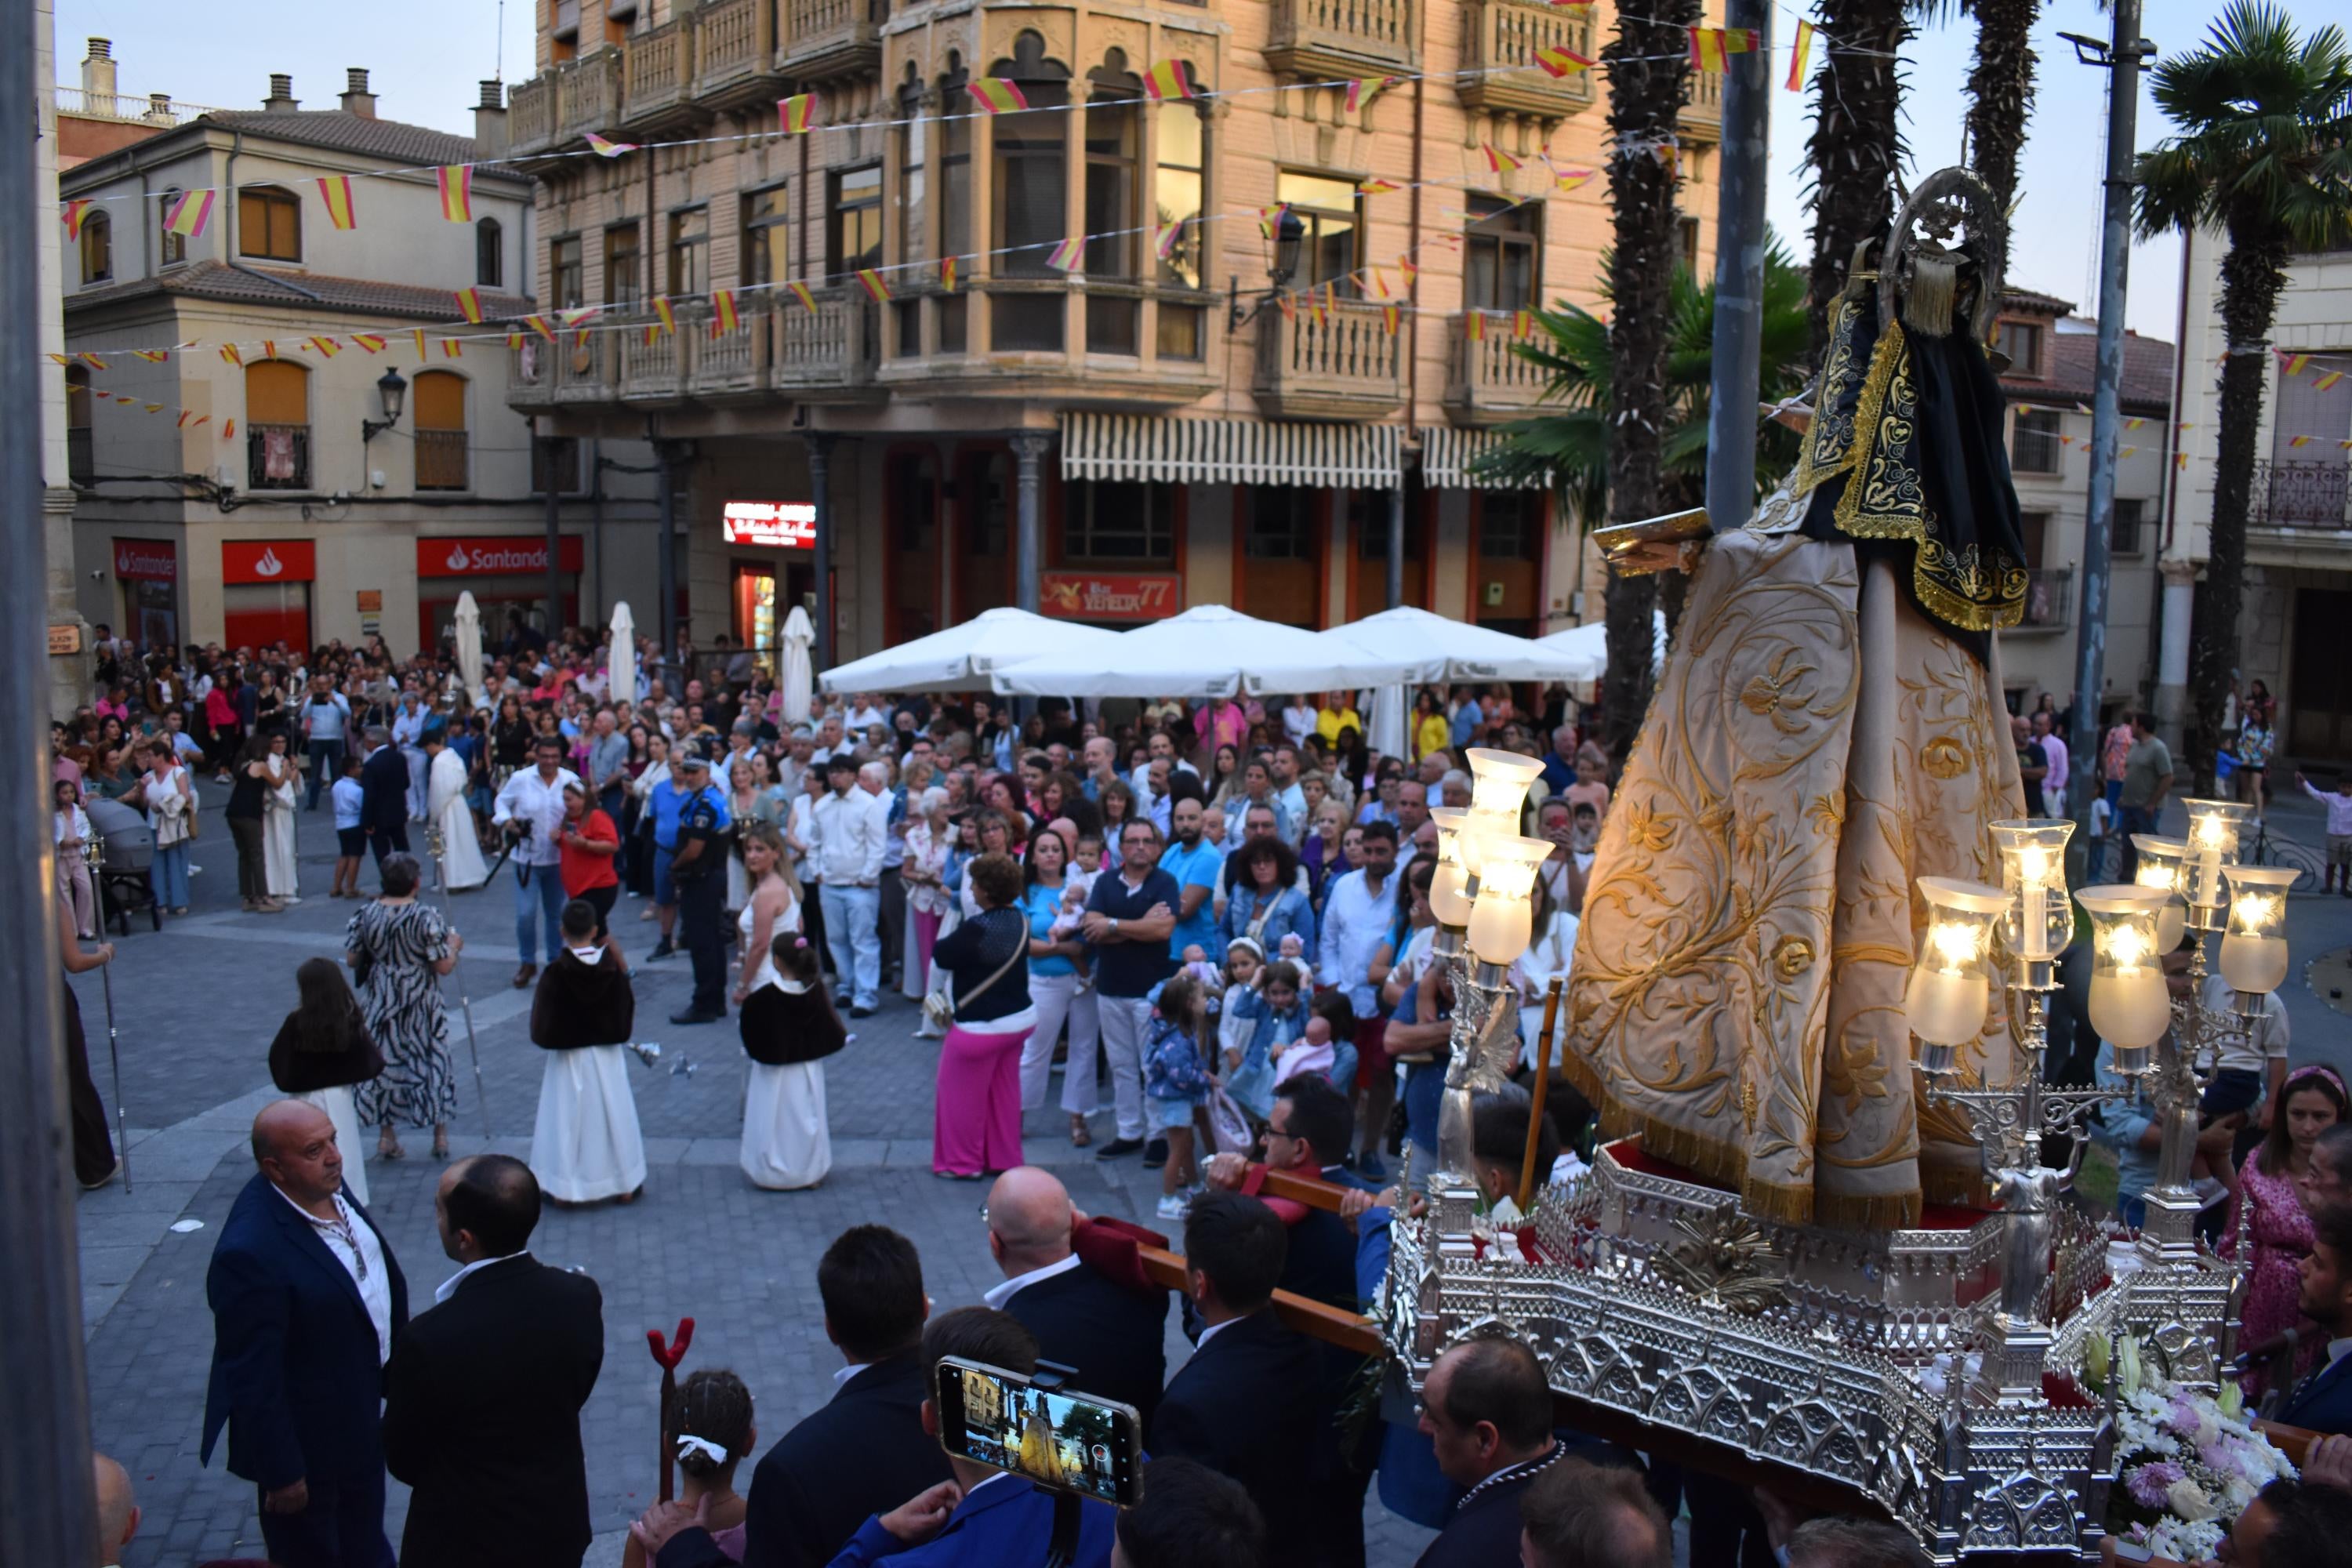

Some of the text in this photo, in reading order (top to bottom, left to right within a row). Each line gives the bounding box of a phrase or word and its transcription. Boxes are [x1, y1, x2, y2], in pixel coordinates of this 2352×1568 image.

[129, 551, 176, 575] Santander
[472, 548, 550, 569] Santande
[1138, 580, 1170, 606] 77
